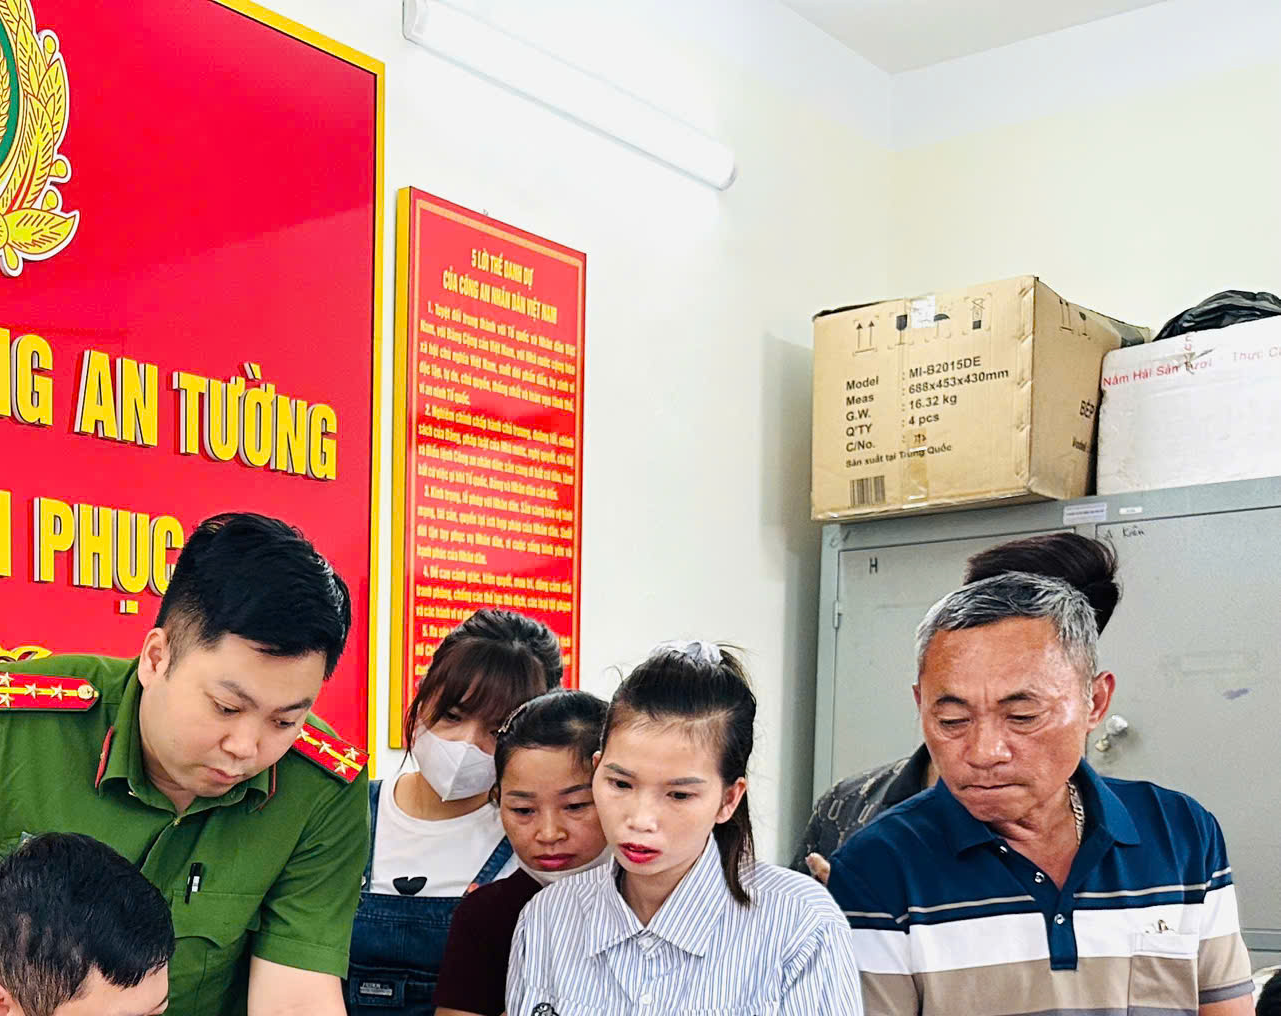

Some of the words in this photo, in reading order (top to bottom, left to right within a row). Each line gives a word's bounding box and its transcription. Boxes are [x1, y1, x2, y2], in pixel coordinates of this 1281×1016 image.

[846, 376, 879, 391] Model
[909, 356, 982, 379] MI-B2015DE
[846, 394, 875, 407] Meas
[908, 369, 1009, 394] 688x453x430mm
[73, 349, 159, 448] AN
[172, 362, 337, 481] TƯỜNG
[846, 408, 872, 422] G.W.
[909, 396, 939, 410] 16.32
[942, 393, 958, 406] kg
[908, 416, 915, 426] 4
[918, 413, 940, 426] pcs
[846, 440, 876, 453] C/No.
[32, 496, 185, 615] PHỤC
